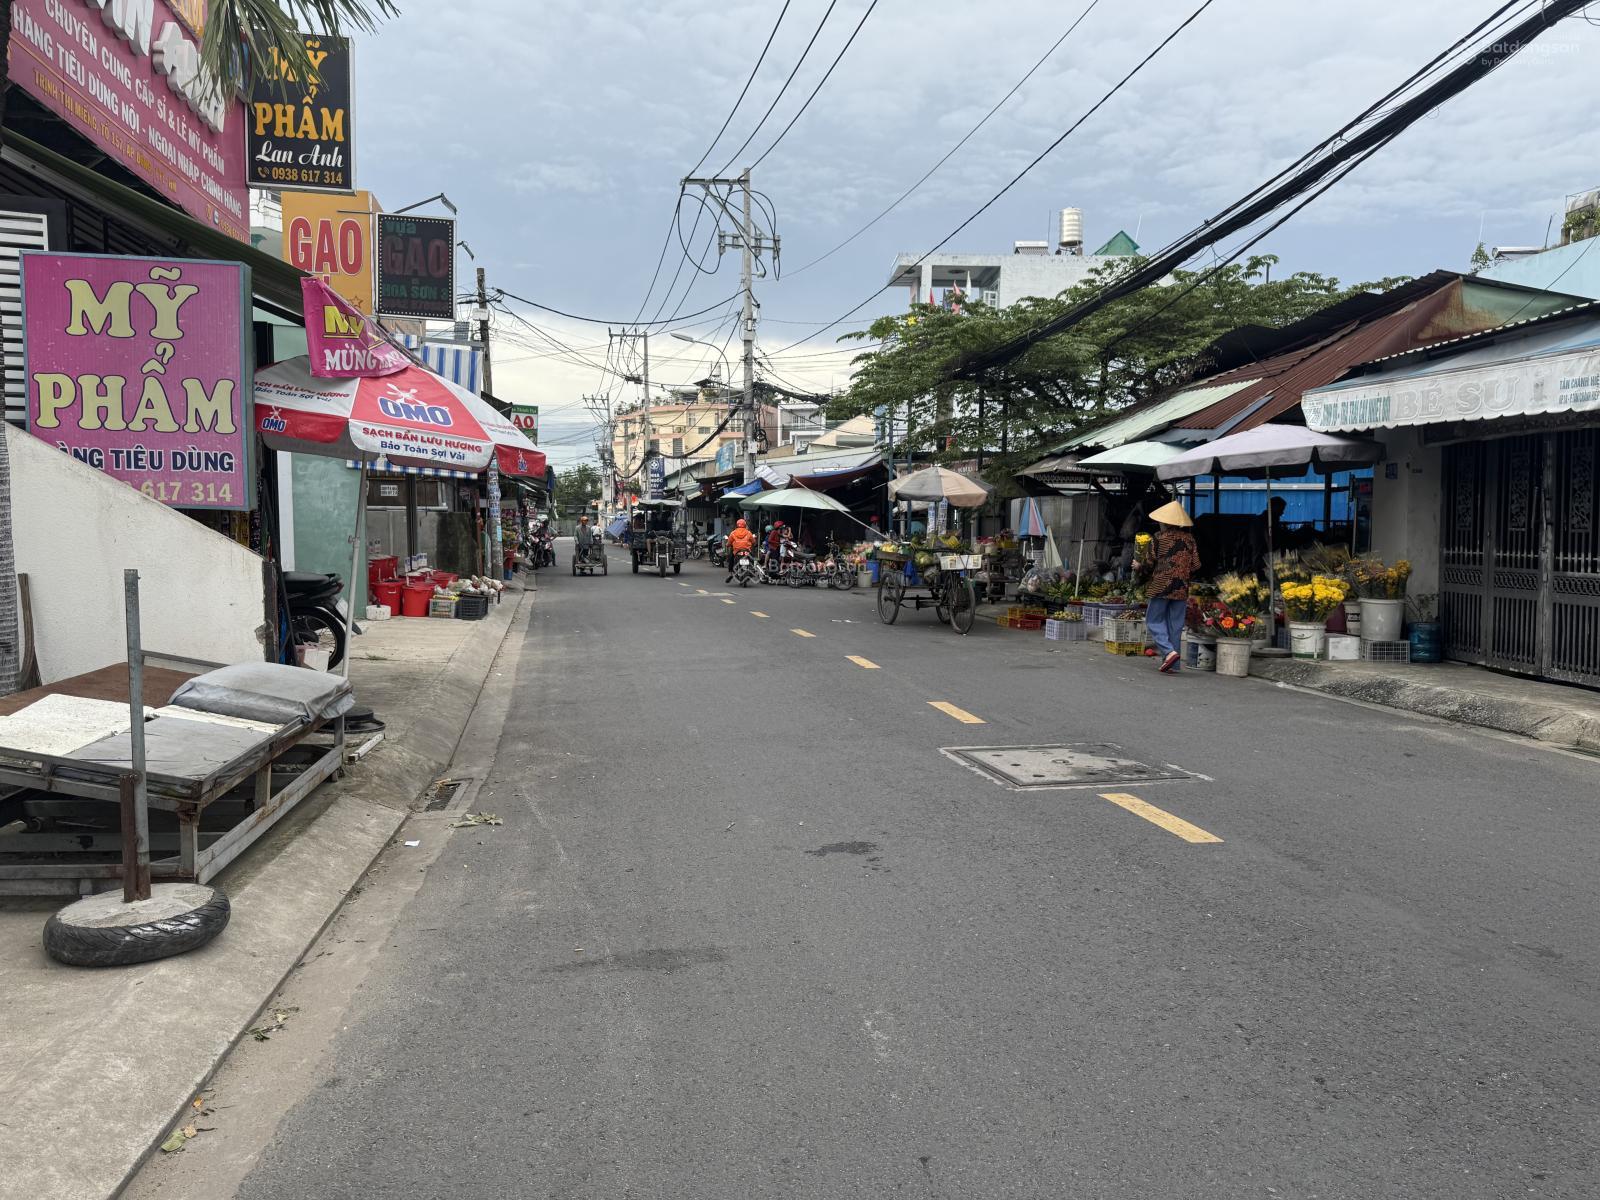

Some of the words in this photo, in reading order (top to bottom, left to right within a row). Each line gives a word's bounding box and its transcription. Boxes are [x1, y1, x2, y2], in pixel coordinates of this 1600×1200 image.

[45, 0, 97, 59] CHUYÊN
[102, 46, 131, 91] CUNG
[168, 110, 175, 130] &
[13, 3, 54, 60] HÀNG
[56, 42, 85, 86] TIÊU
[88, 71, 118, 116] DÙNG
[121, 101, 140, 135] NỘI
[148, 125, 176, 165] NGOẠI
[177, 151, 200, 184] NHẬP
[201, 172, 223, 203] CHÍNH
[254, 85, 345, 142] PHẨM
[255, 141, 294, 163] Lan
[298, 144, 344, 168] Anh
[271, 167, 298, 182] 0938
[301, 168, 320, 183] 617
[323, 170, 343, 185] 314
[64, 266, 200, 340] MỸ
[32, 341, 237, 433] PHẨM
[1393, 380, 1445, 419] BÉ
[1455, 376, 1520, 414] SU
[262, 417, 286, 432] OMO
[378, 397, 453, 427] OMO
[362, 427, 393, 438] SẠCH
[444, 440, 482, 453] HƯƠNG
[380, 440, 400, 450] Bảo
[403, 444, 428, 454] Toàn
[431, 448, 447, 459] Sợi
[449, 450, 465, 460] Vải
[109, 443, 163, 471] TIÊU
[170, 445, 234, 473] DÙNG
[140, 479, 182, 501] 617
[191, 481, 233, 503] 314
